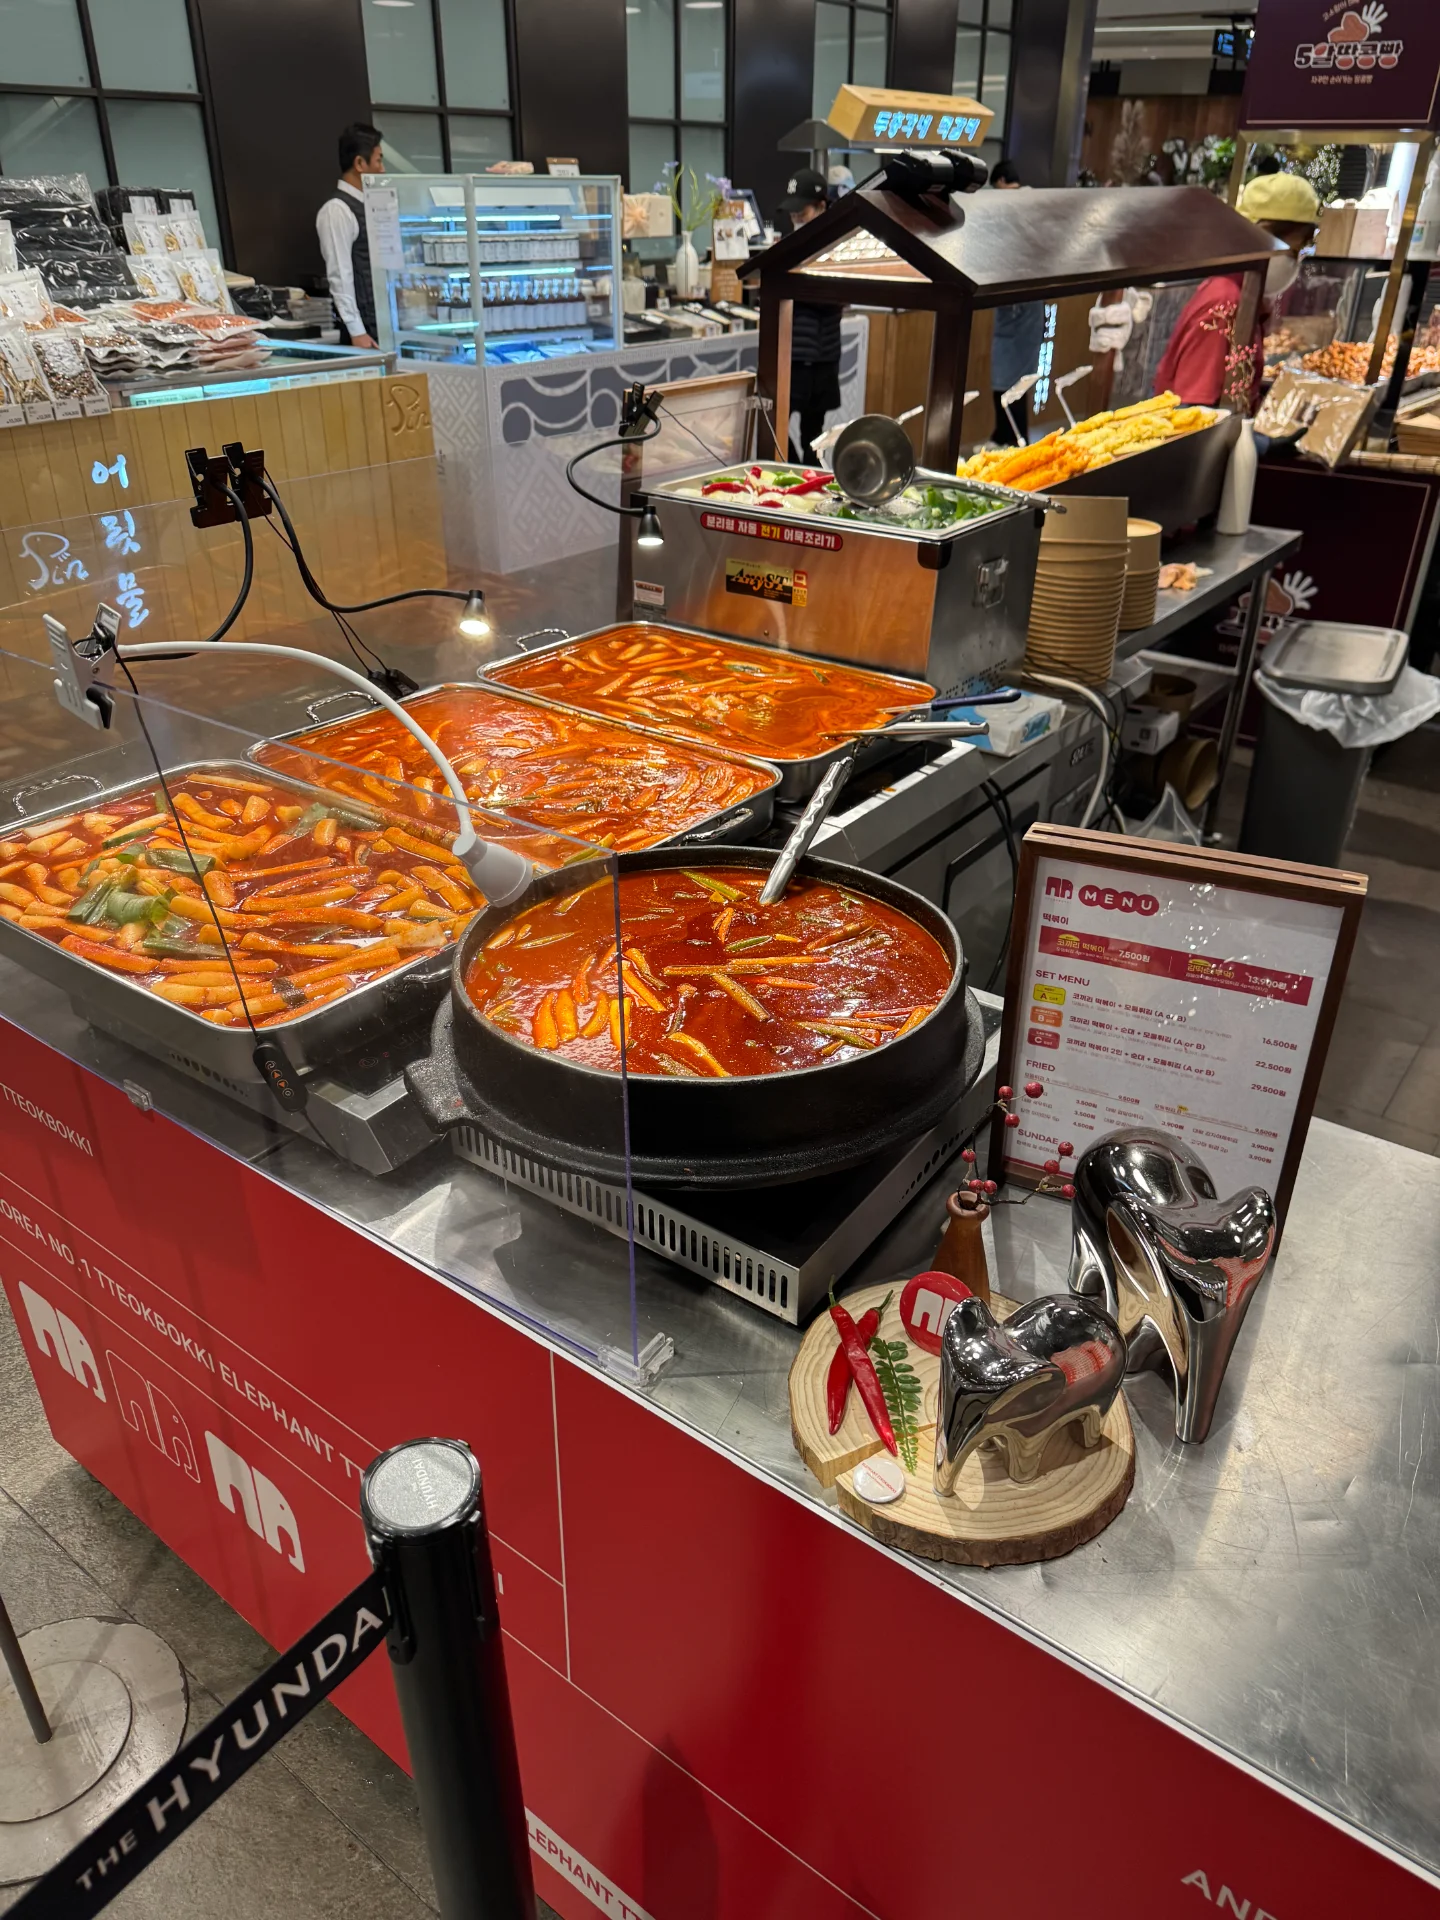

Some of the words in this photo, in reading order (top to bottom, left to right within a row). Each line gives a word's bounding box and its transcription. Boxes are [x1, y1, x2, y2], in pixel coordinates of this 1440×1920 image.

[706, 515, 735, 531] 분리형
[738, 520, 757, 535] 자동
[761, 524, 780, 539] 전기
[784, 529, 836, 548] 어묵조리기
[1084, 889, 1152, 911] MENU
[1042, 912, 1069, 925] 떡볶이
[1057, 939, 1081, 949] 코끼리
[1082, 942, 1105, 953] 떡볶이
[1035, 969, 1056, 980] SET
[1058, 973, 1090, 987] MENU
[1040, 992, 1048, 1000] A
[1072, 992, 1093, 1003] 코끼리
[1095, 997, 1117, 1008] 떡볶이
[1038, 1014, 1045, 1022] B
[1069, 1015, 1090, 1026] 코끼리
[1091, 1020, 1113, 1031] 떡볶이
[1034, 1036, 1043, 1044] C
[1066, 1037, 1087, 1048] 코끼리
[1088, 1042, 1109, 1052] 떡볶이
[1025, 1059, 1056, 1072] FRIED
[0, 1082, 94, 1157] TTEOKBOKKI
[1017, 1128, 1059, 1145] SUNDAE
[93, 1266, 216, 1374] TTEOKBOKKI
[219, 1361, 334, 1463] ELEPHANT
[411, 1458, 439, 1509] HYUNDAI
[75, 1827, 139, 1892] THE
[526, 1819, 614, 1905] LEPHANT
